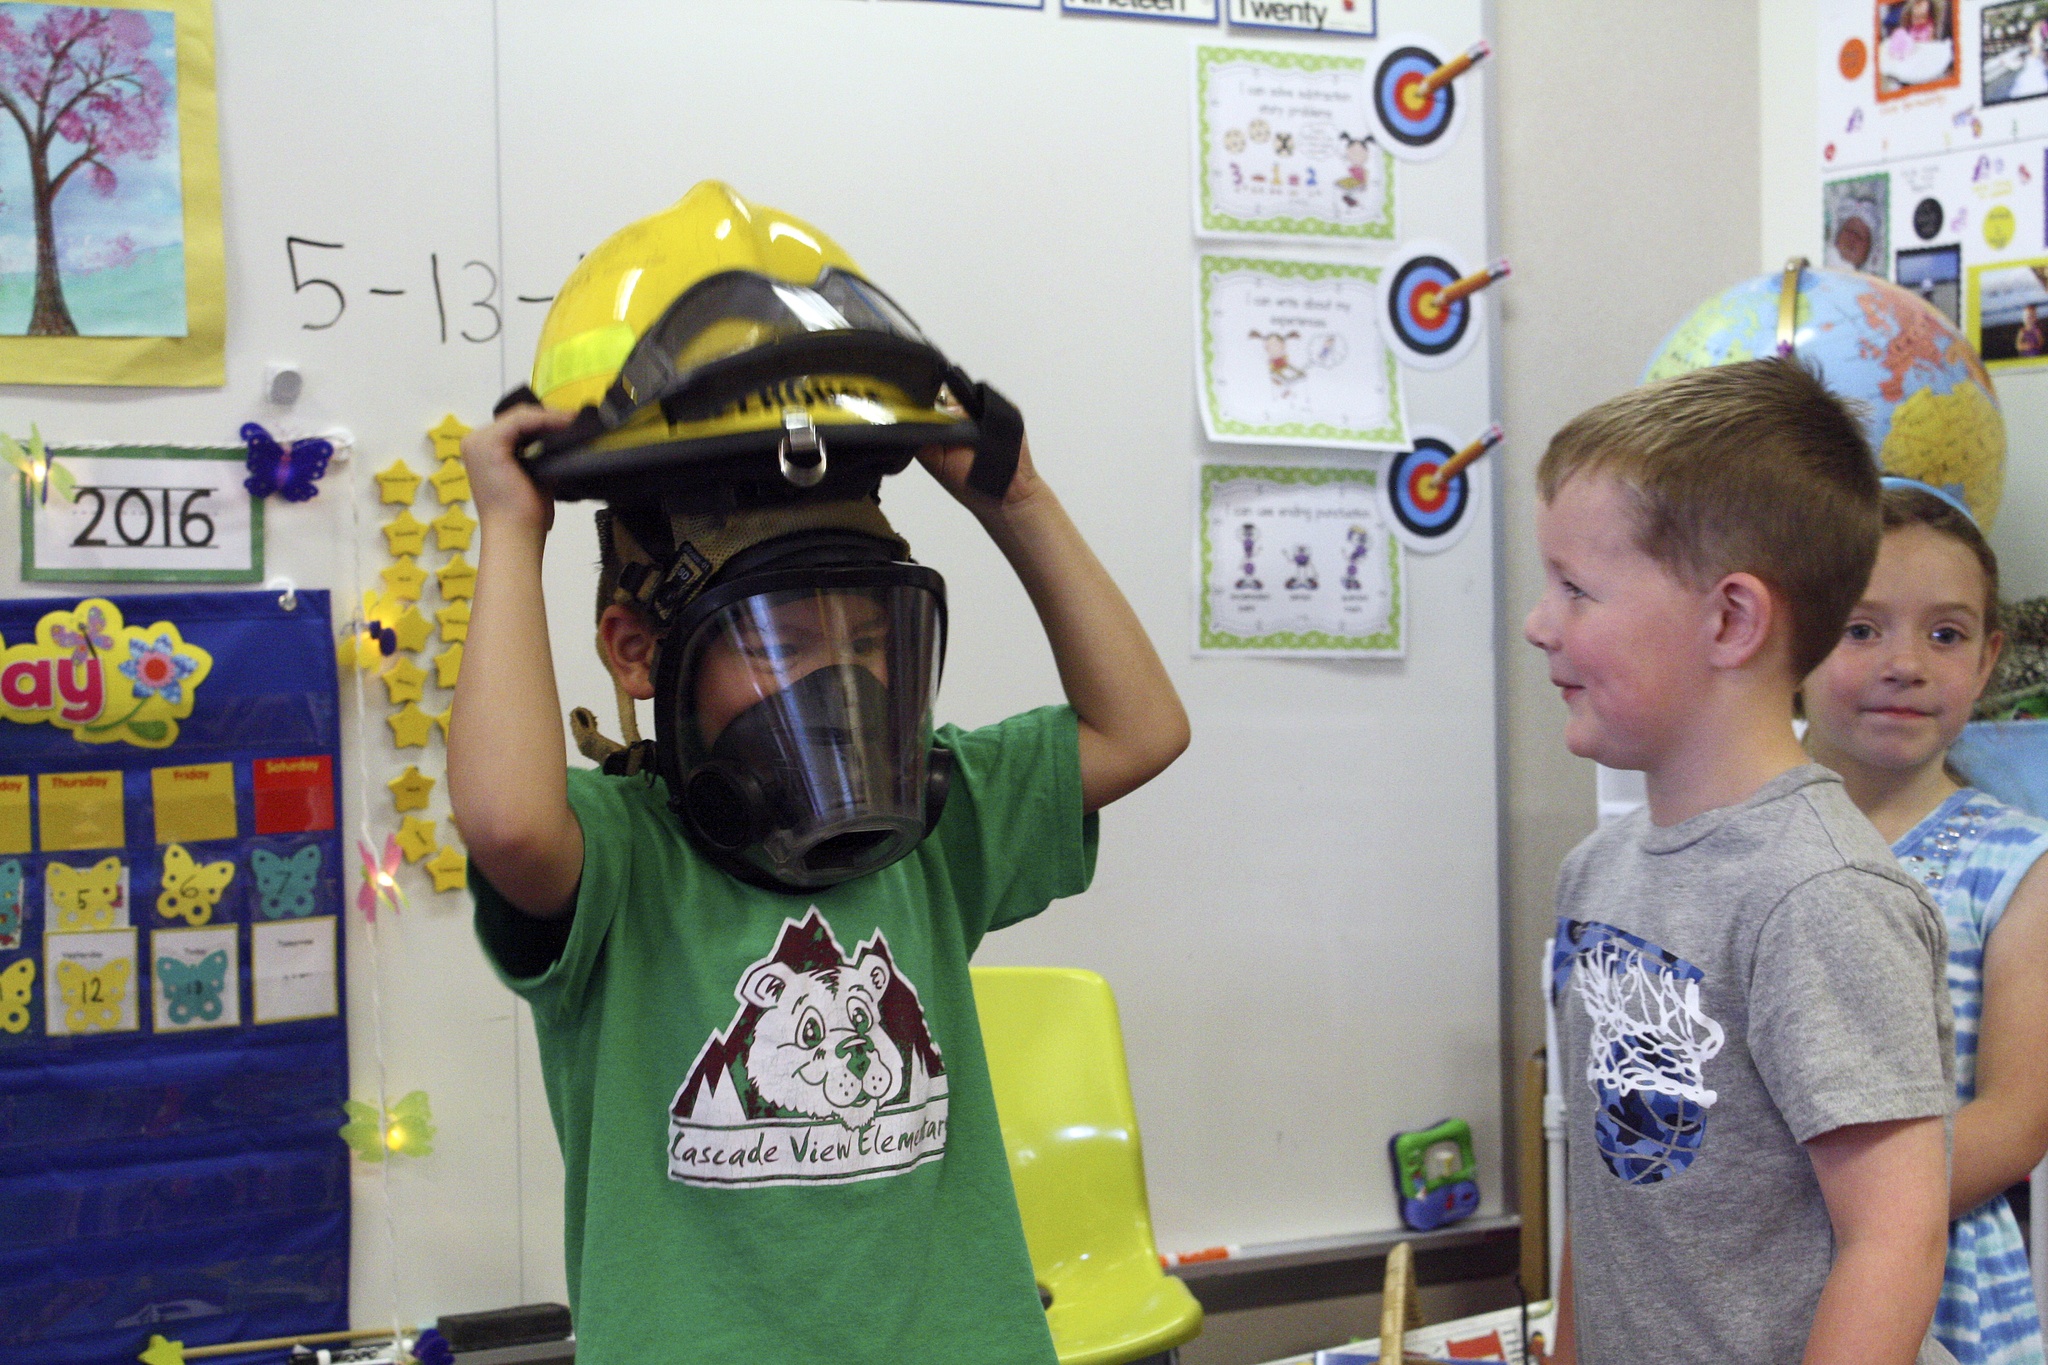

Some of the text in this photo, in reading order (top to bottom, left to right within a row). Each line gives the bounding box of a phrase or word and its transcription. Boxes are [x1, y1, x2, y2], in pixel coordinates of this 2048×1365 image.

[73, 487, 215, 547] 2016
[52, 775, 109, 790] Thursday
[173, 768, 210, 782] Friday
[265, 760, 320, 775] Saturday
[77, 870, 293, 910] 5 6 7
[82, 976, 105, 1004] 12
[671, 1116, 947, 1167] Cascade View Elementar
